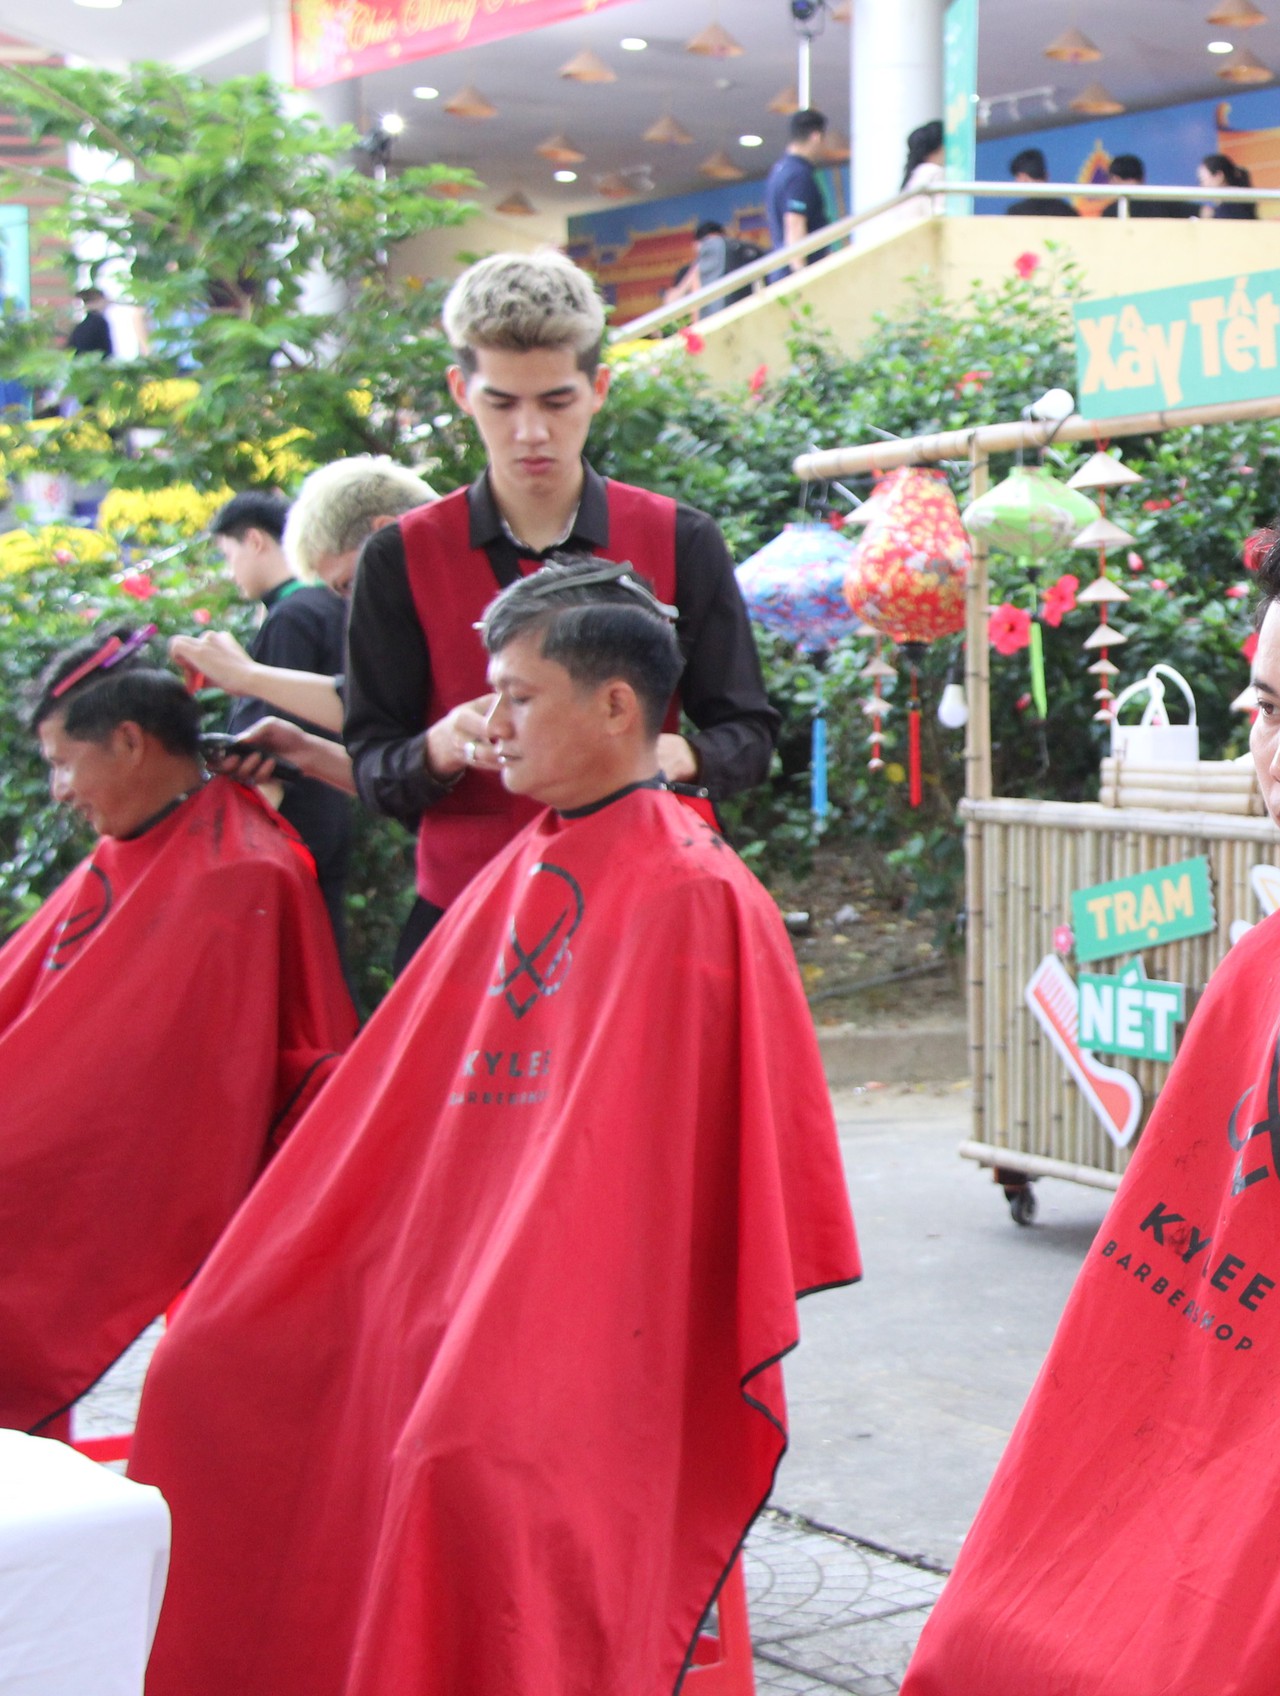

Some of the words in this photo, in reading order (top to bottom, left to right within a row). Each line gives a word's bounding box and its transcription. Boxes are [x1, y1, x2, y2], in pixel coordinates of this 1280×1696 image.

[1078, 304, 1187, 408] Xây
[1190, 276, 1280, 378] Tết
[1087, 873, 1194, 941] TRẠM
[1080, 968, 1178, 1054] NÉT
[1101, 1240, 1253, 1351] BARBERSHOP
[1139, 1202, 1276, 1312] KYEE
